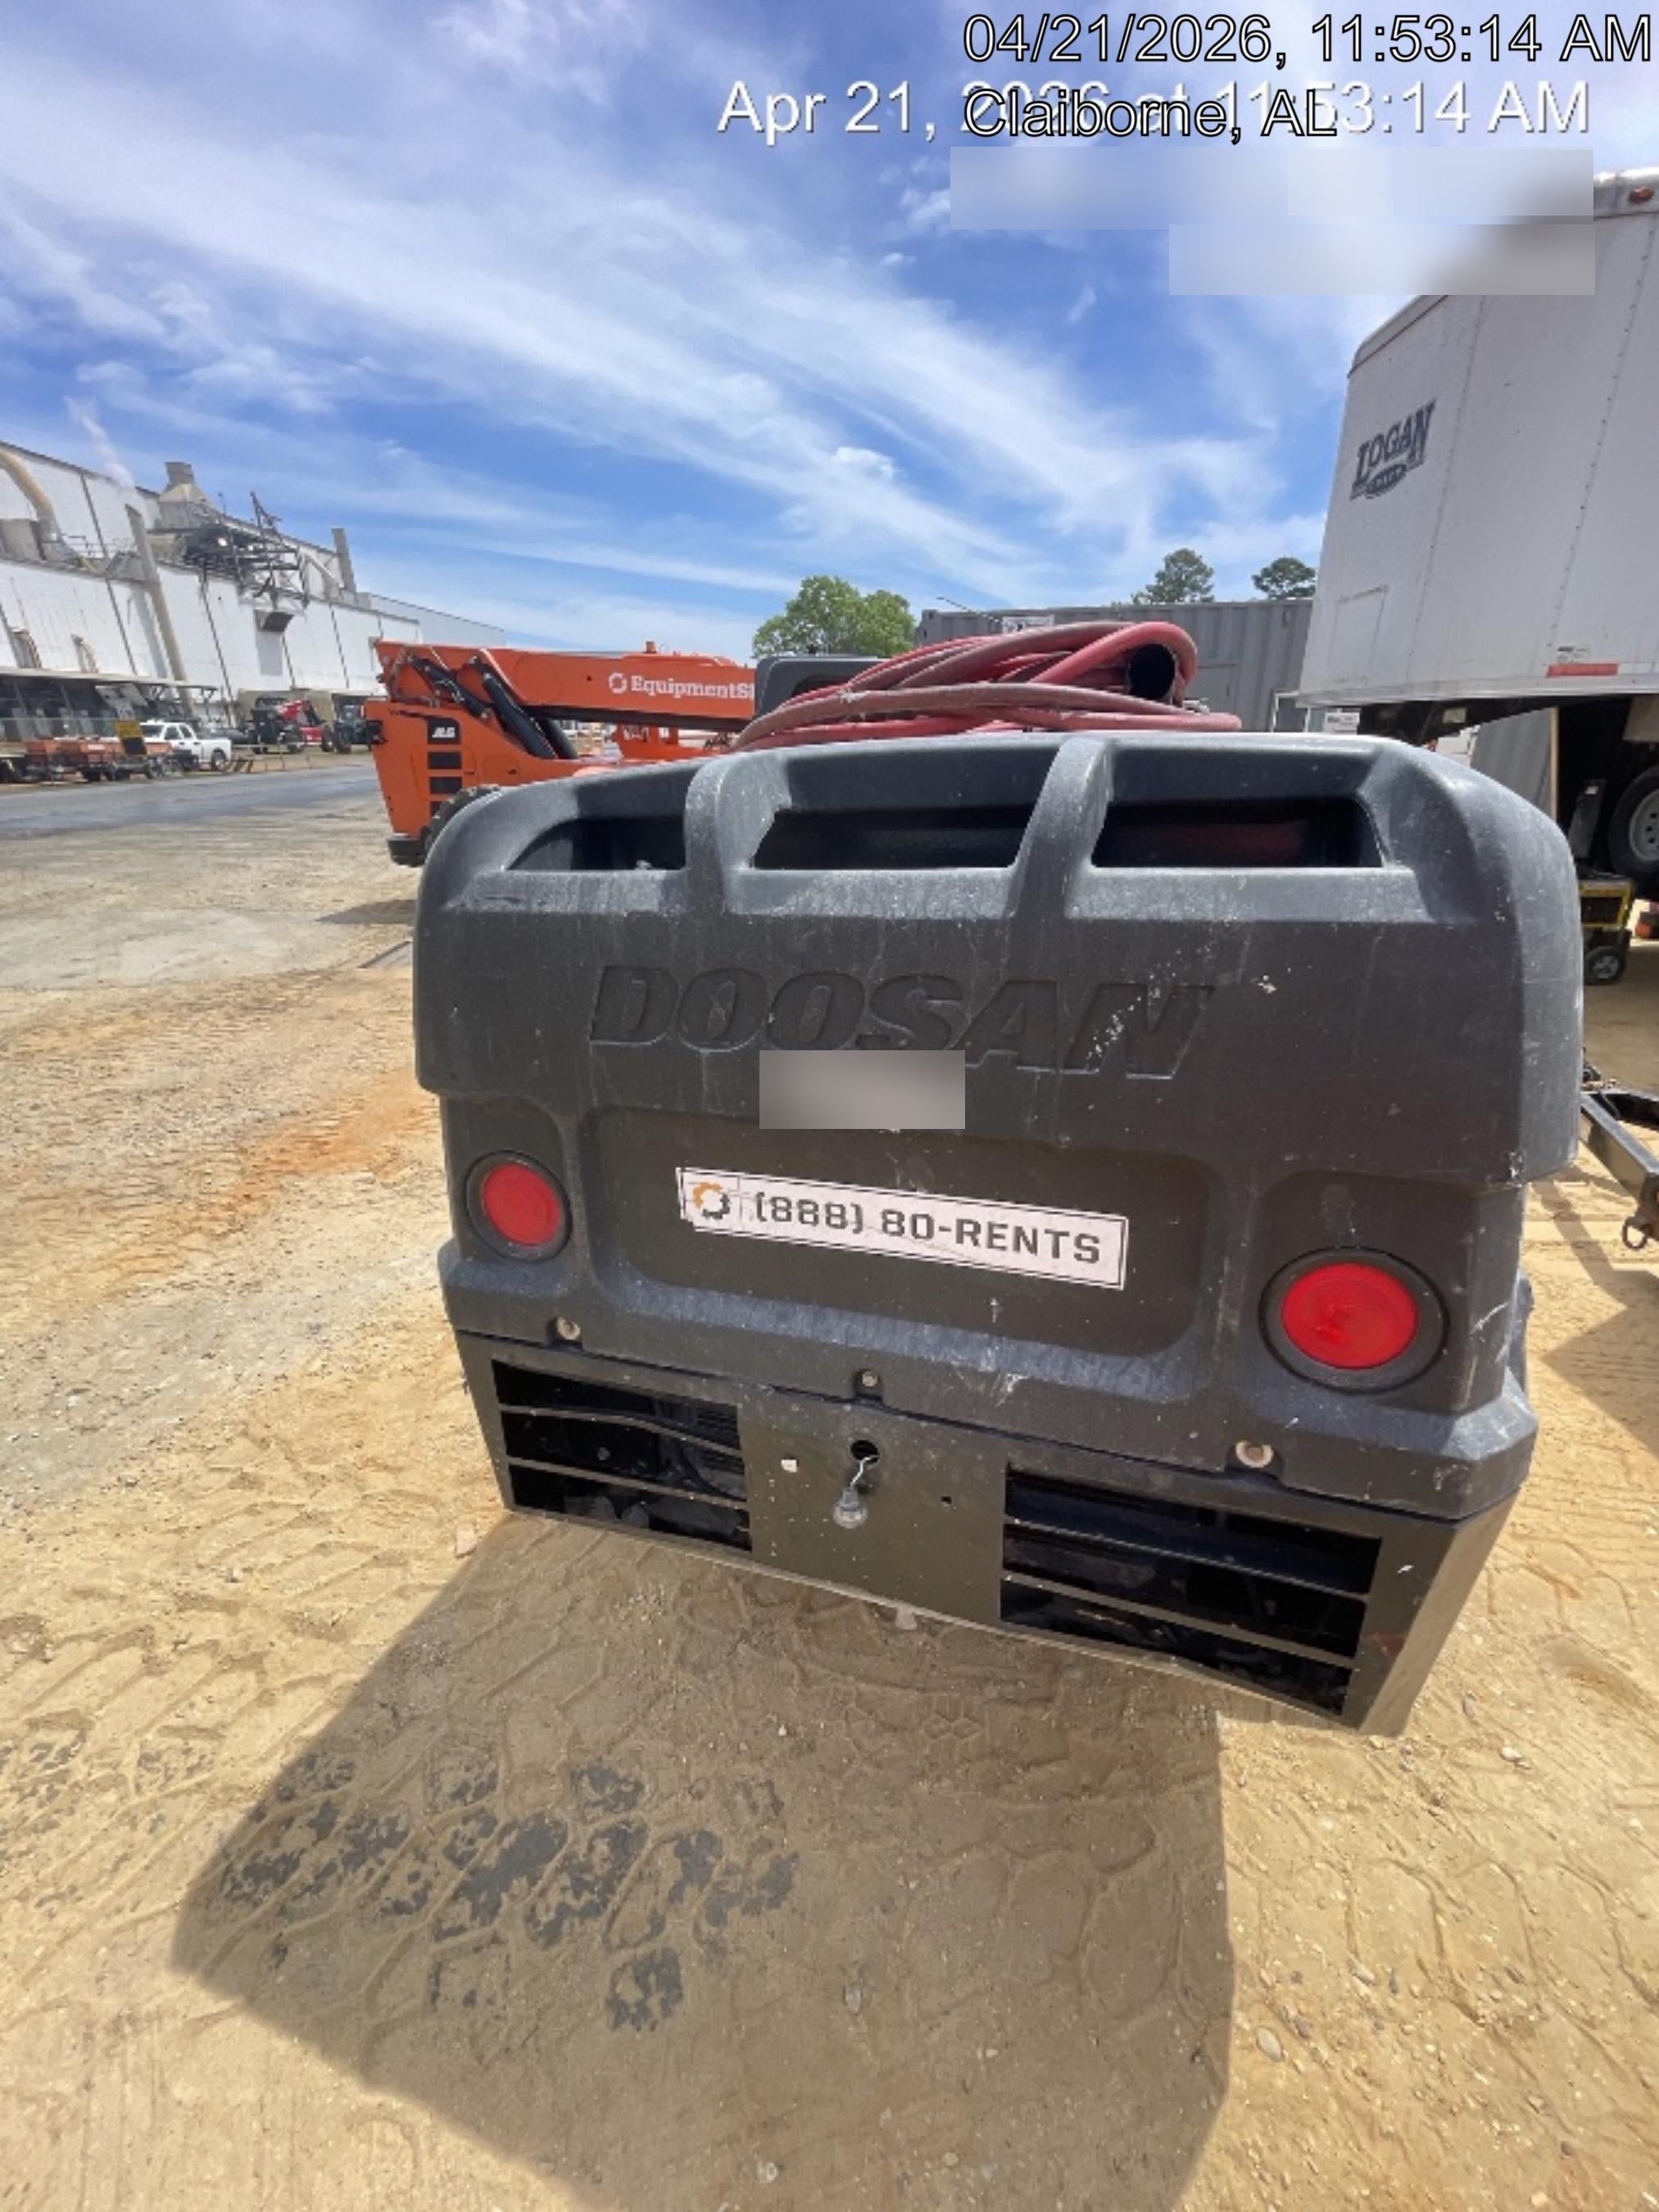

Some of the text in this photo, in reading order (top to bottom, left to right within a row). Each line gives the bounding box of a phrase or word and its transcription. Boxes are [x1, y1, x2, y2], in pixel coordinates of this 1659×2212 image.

[589, 964, 1216, 1080] DOOSAN
[755, 1191, 1100, 1265] (888) 80-RENTS
